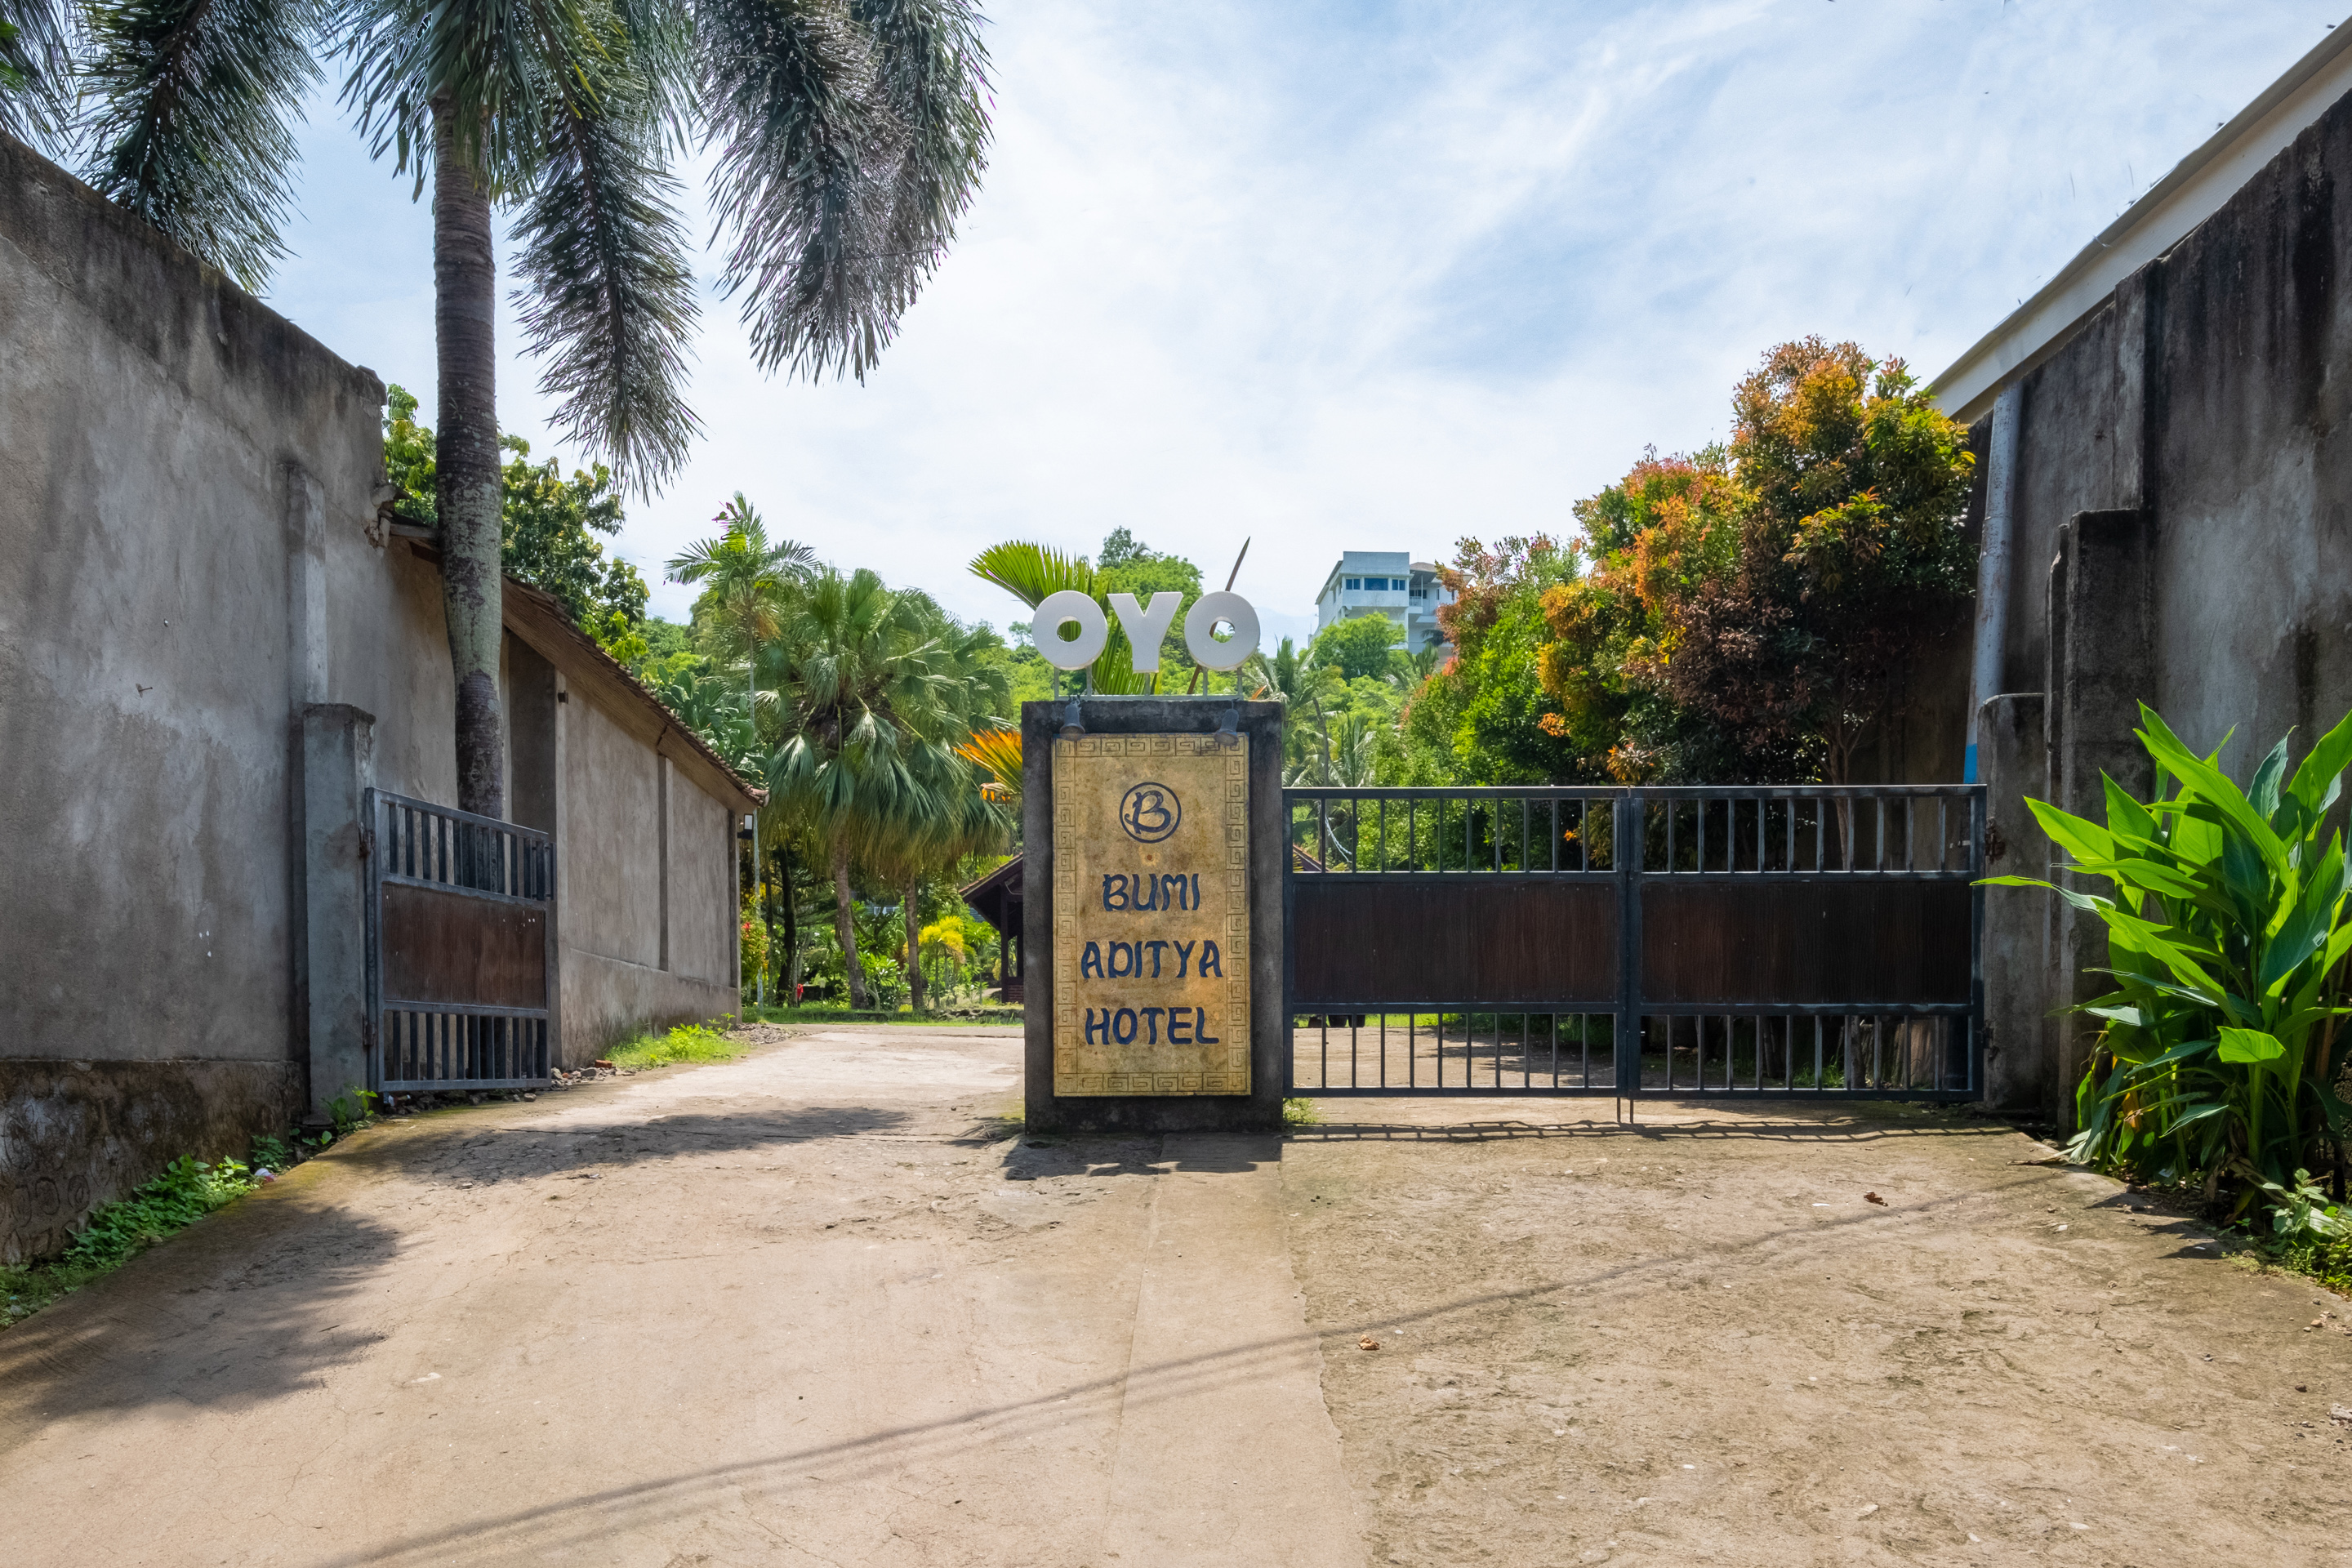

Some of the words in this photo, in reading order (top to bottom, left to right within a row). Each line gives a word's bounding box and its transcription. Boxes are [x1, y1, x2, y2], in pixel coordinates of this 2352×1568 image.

[1031, 590, 1260, 673] OYO
[1124, 790, 1171, 835] B
[1102, 873, 1200, 911] BUMI
[1080, 940, 1223, 978] ADITYA
[1085, 1006, 1219, 1045] HOTEL
